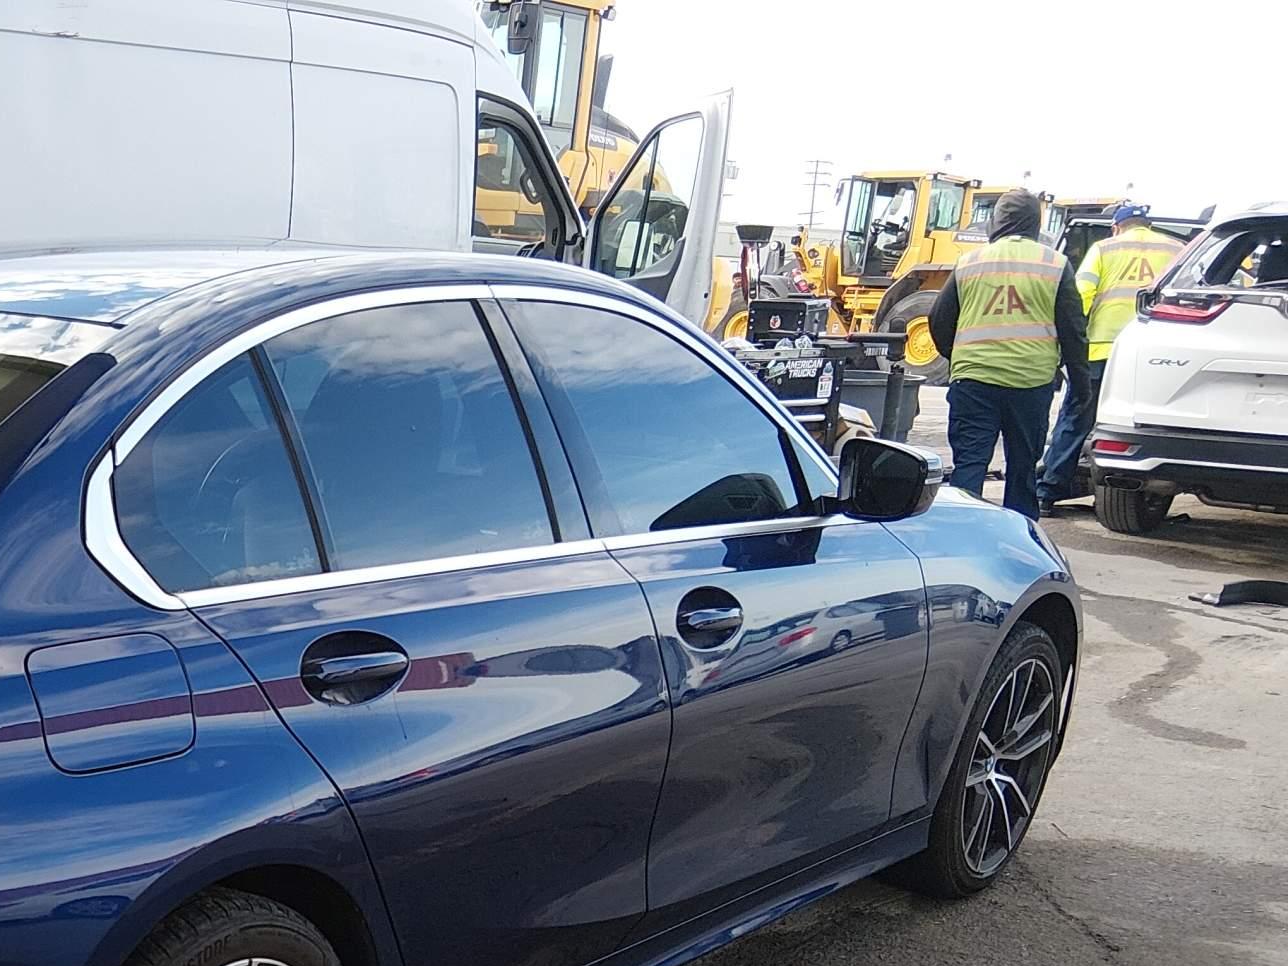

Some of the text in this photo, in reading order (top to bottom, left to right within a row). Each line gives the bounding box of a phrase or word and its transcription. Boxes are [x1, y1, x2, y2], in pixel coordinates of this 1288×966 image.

[785, 358, 824, 370] AMERICAN
[1148, 358, 1191, 367] CR-V
[788, 368, 818, 379] TRUCKS
